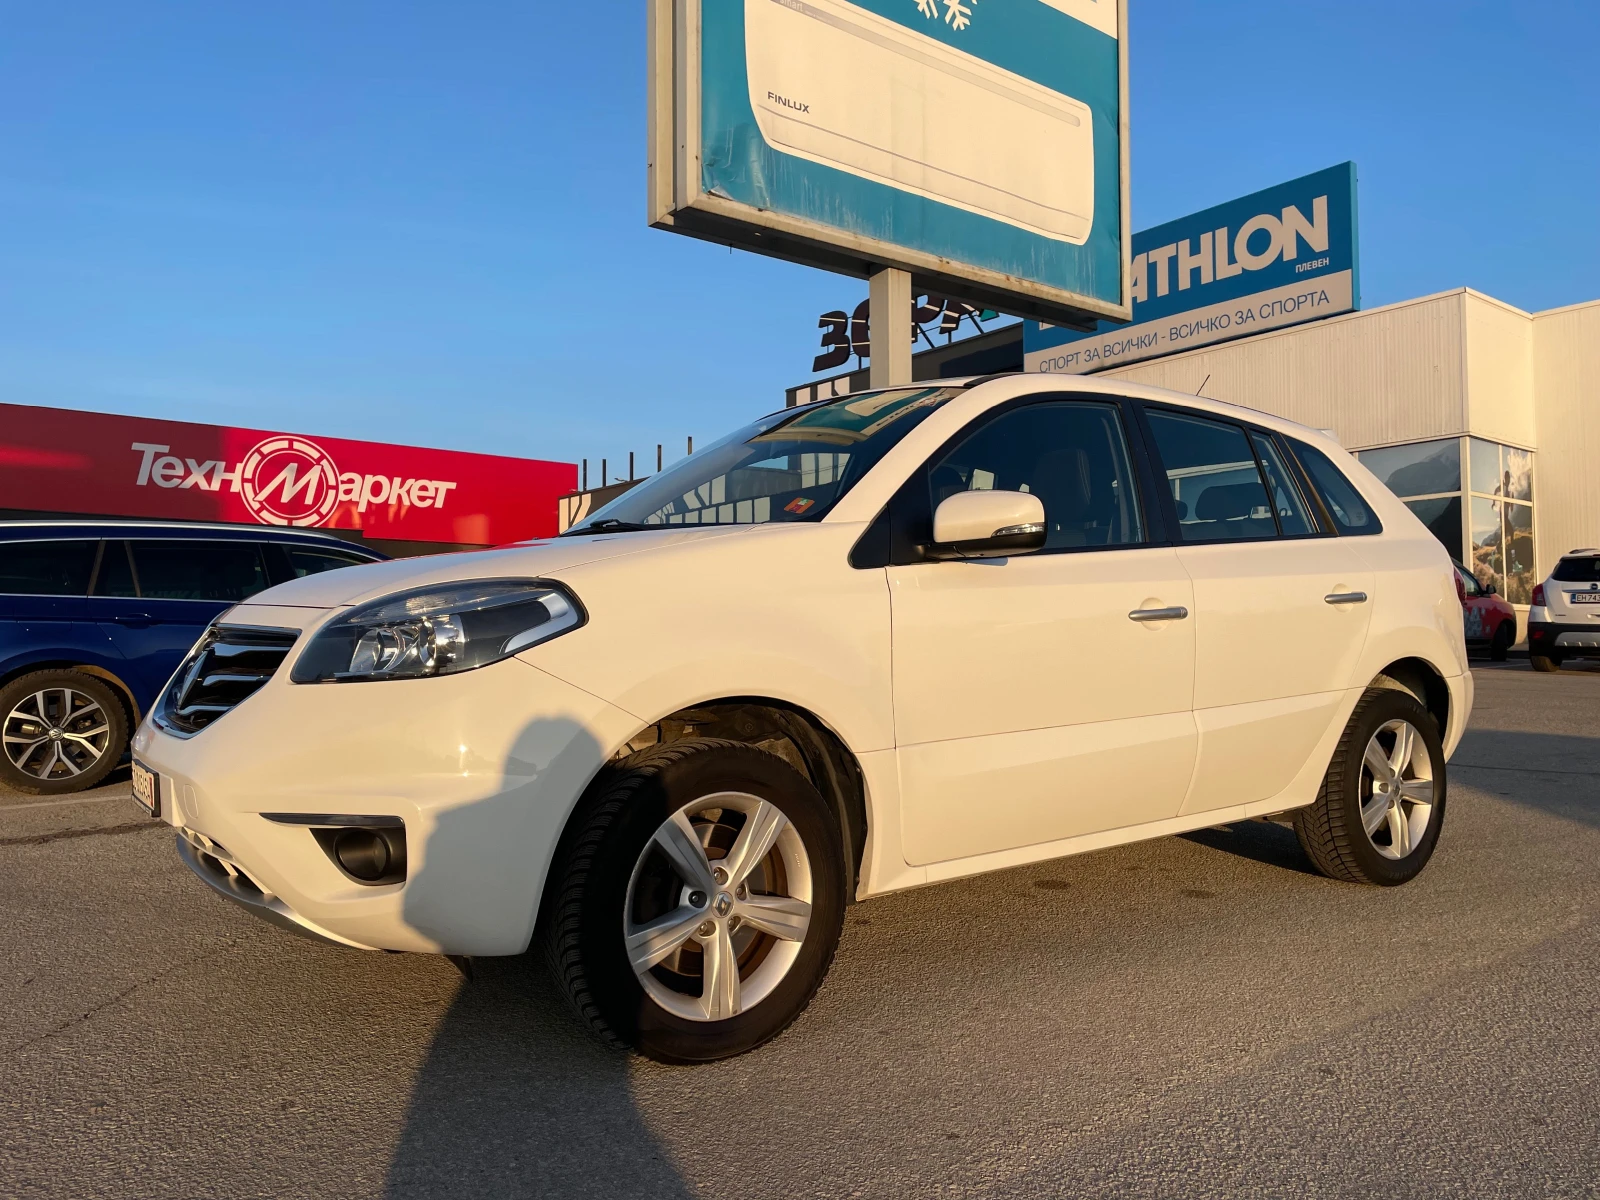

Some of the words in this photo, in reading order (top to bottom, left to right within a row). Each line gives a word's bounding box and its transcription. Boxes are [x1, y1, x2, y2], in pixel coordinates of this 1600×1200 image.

[767, 91, 810, 114] FINLUX
[1131, 195, 1329, 303] ATHLON
[1295, 257, 1330, 273] ПЛЕВЕН
[1039, 352, 1081, 373] СПОРТ
[1084, 348, 1100, 363] ЗА
[1103, 332, 1158, 358] ВСИЧКИ
[1169, 314, 1231, 341] ВСИЧКО
[1235, 309, 1256, 325] ЗА
[1259, 290, 1330, 319] СПОРТА
